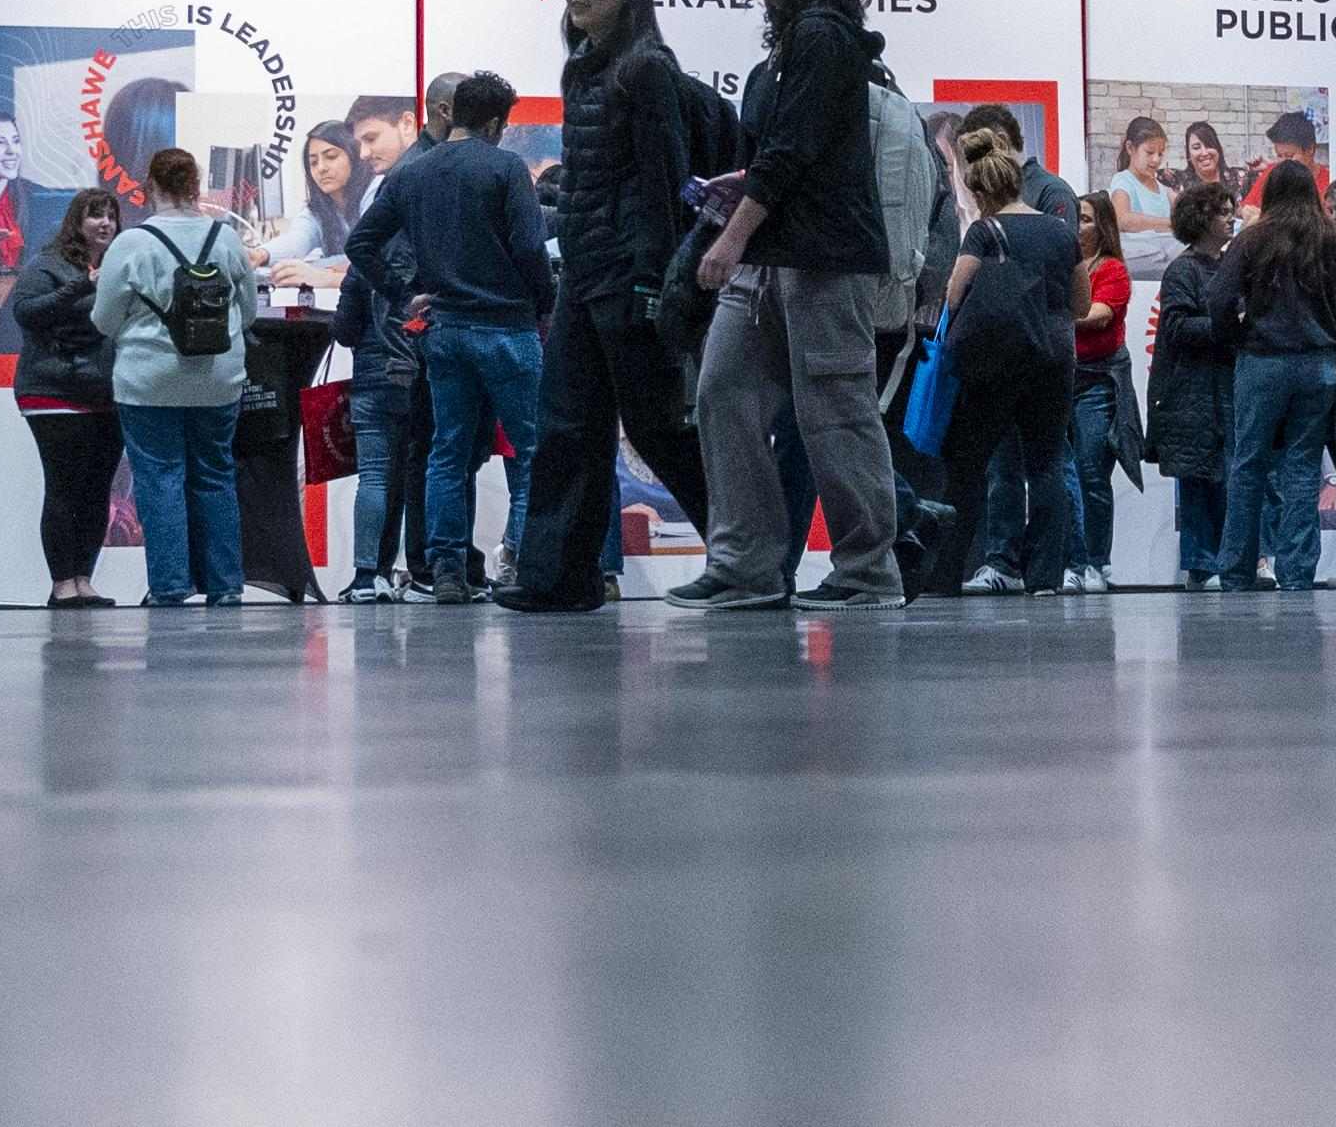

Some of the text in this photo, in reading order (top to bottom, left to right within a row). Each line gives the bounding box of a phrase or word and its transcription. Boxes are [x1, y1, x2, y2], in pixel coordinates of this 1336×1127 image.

[111, 4, 179, 48] THIS
[187, 4, 213, 25] IS
[220, 12, 296, 181] LEADERSHIP
